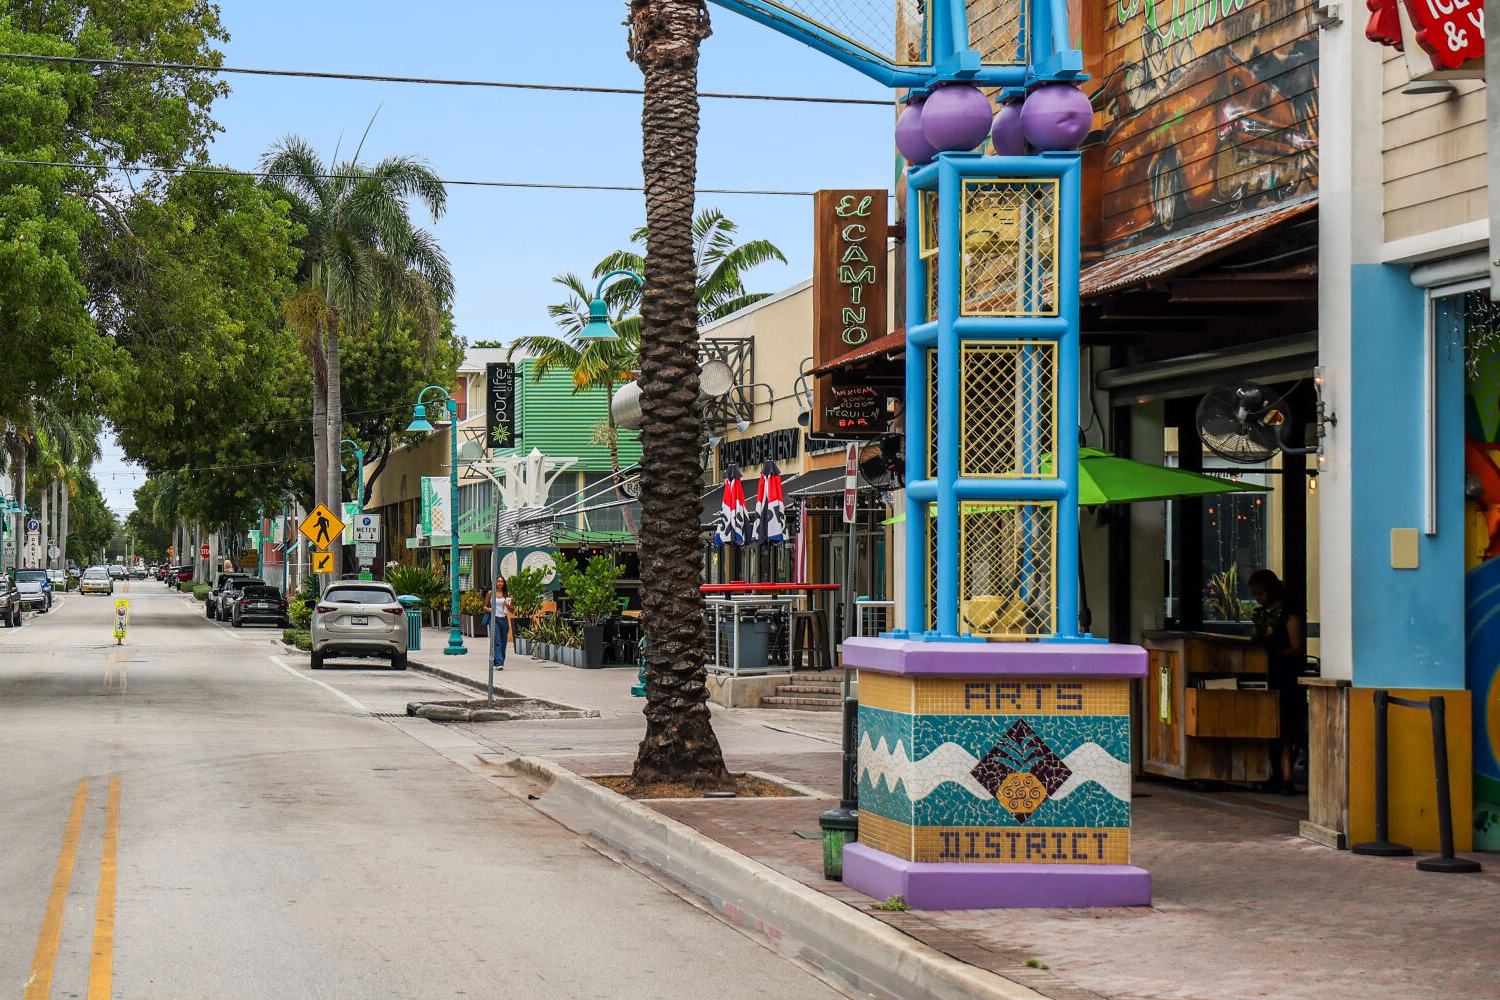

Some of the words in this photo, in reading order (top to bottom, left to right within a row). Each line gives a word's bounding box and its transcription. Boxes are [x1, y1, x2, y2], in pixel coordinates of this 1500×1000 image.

[1444, 21, 1469, 52] &
[835, 195, 873, 217] El
[838, 223, 876, 345] CAMINO
[827, 409, 878, 419] TEQUILA
[839, 418, 869, 427] BAR
[763, 428, 799, 463] EATERY
[964, 683, 1083, 710] ARTS
[939, 831, 1108, 859] DISTRICT
